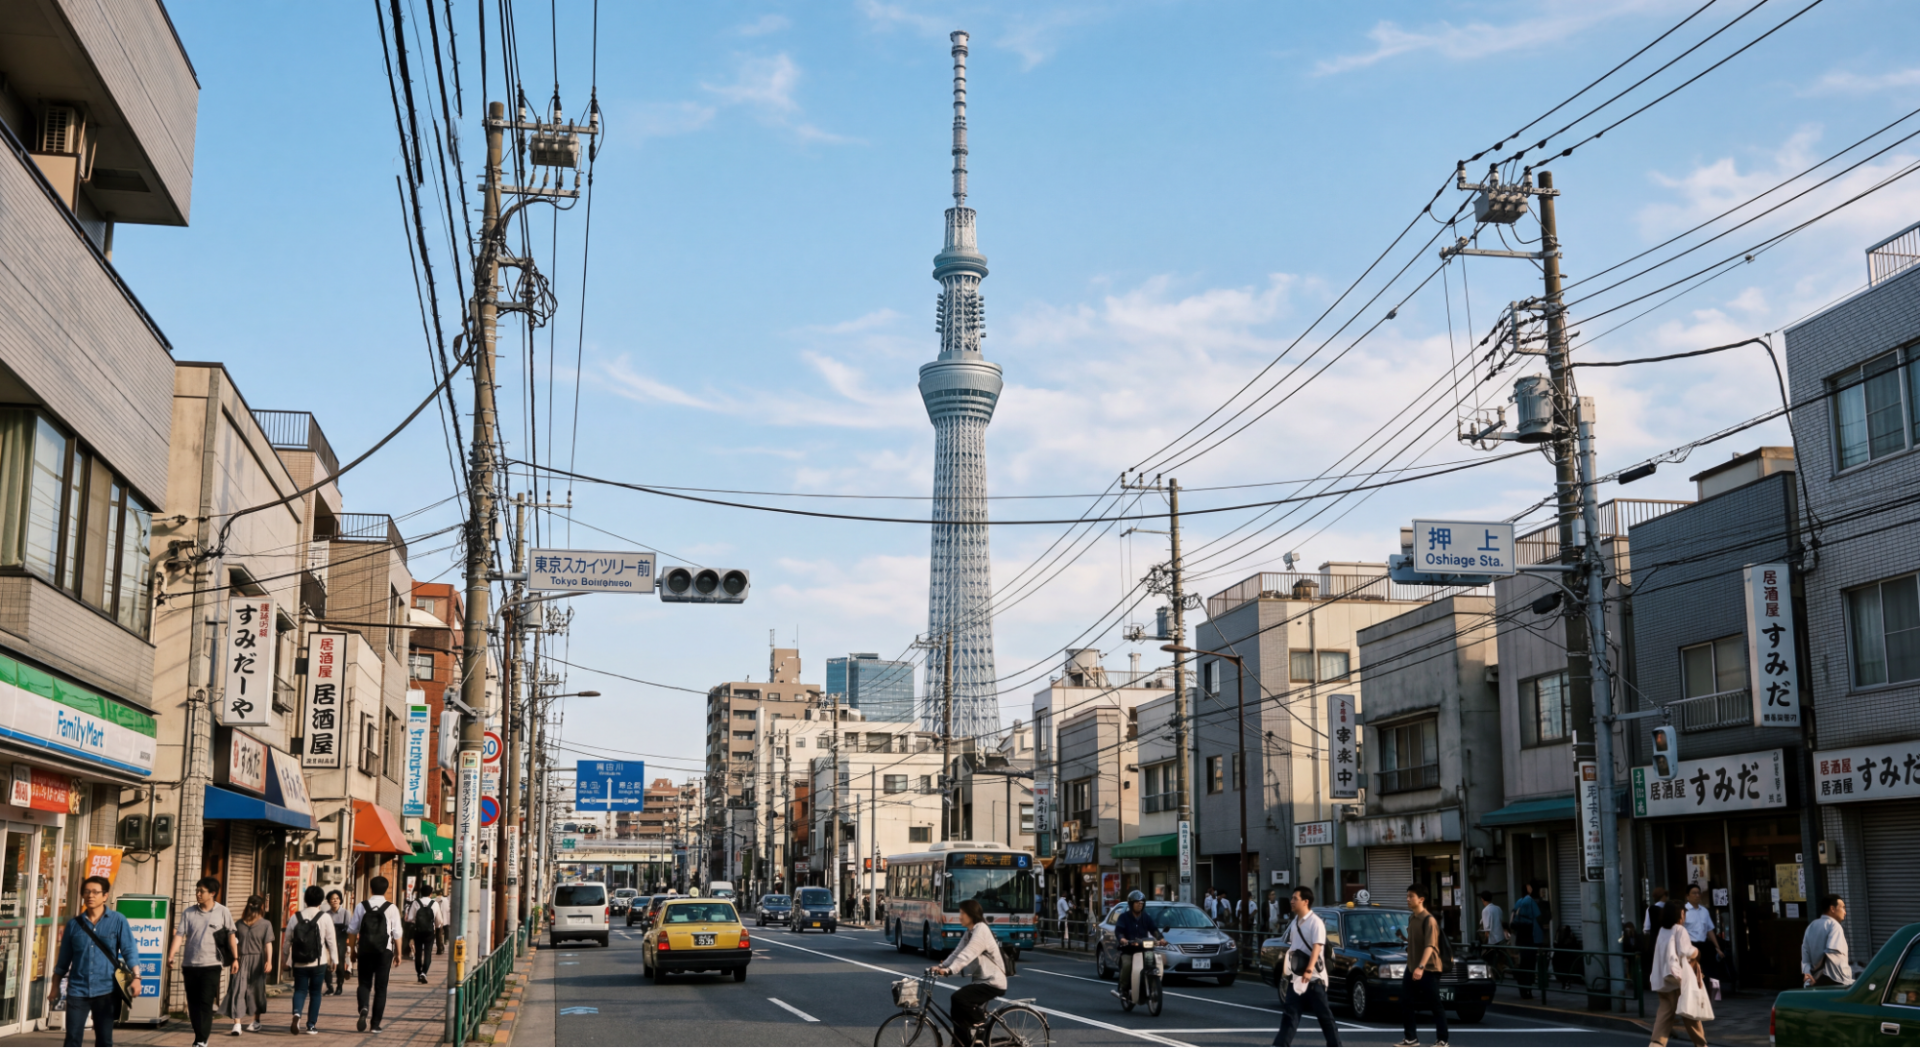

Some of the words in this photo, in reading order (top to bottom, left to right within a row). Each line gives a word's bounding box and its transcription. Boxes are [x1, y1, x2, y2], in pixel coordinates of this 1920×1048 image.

[1428, 527, 1500, 551] 押上
[534, 555, 651, 577] 東京スカイツリー前
[1425, 553, 1476, 568] Oshiage
[1479, 554, 1504, 567] Sta.
[550, 576, 578, 587] Tokyo
[1763, 570, 1780, 617] 居酒屋
[230, 604, 258, 720] すみだーや
[1762, 622, 1791, 707] すみだ
[57, 710, 104, 748] FamilyMart
[310, 683, 336, 755] 居酒屋
[1820, 758, 1852, 775] 居酒屋
[1857, 753, 1920, 791] すみだ
[1650, 778, 1686, 801] 居酒屋
[1690, 762, 1760, 806] すみだ
[1821, 778, 1854, 796] 居酒屋
